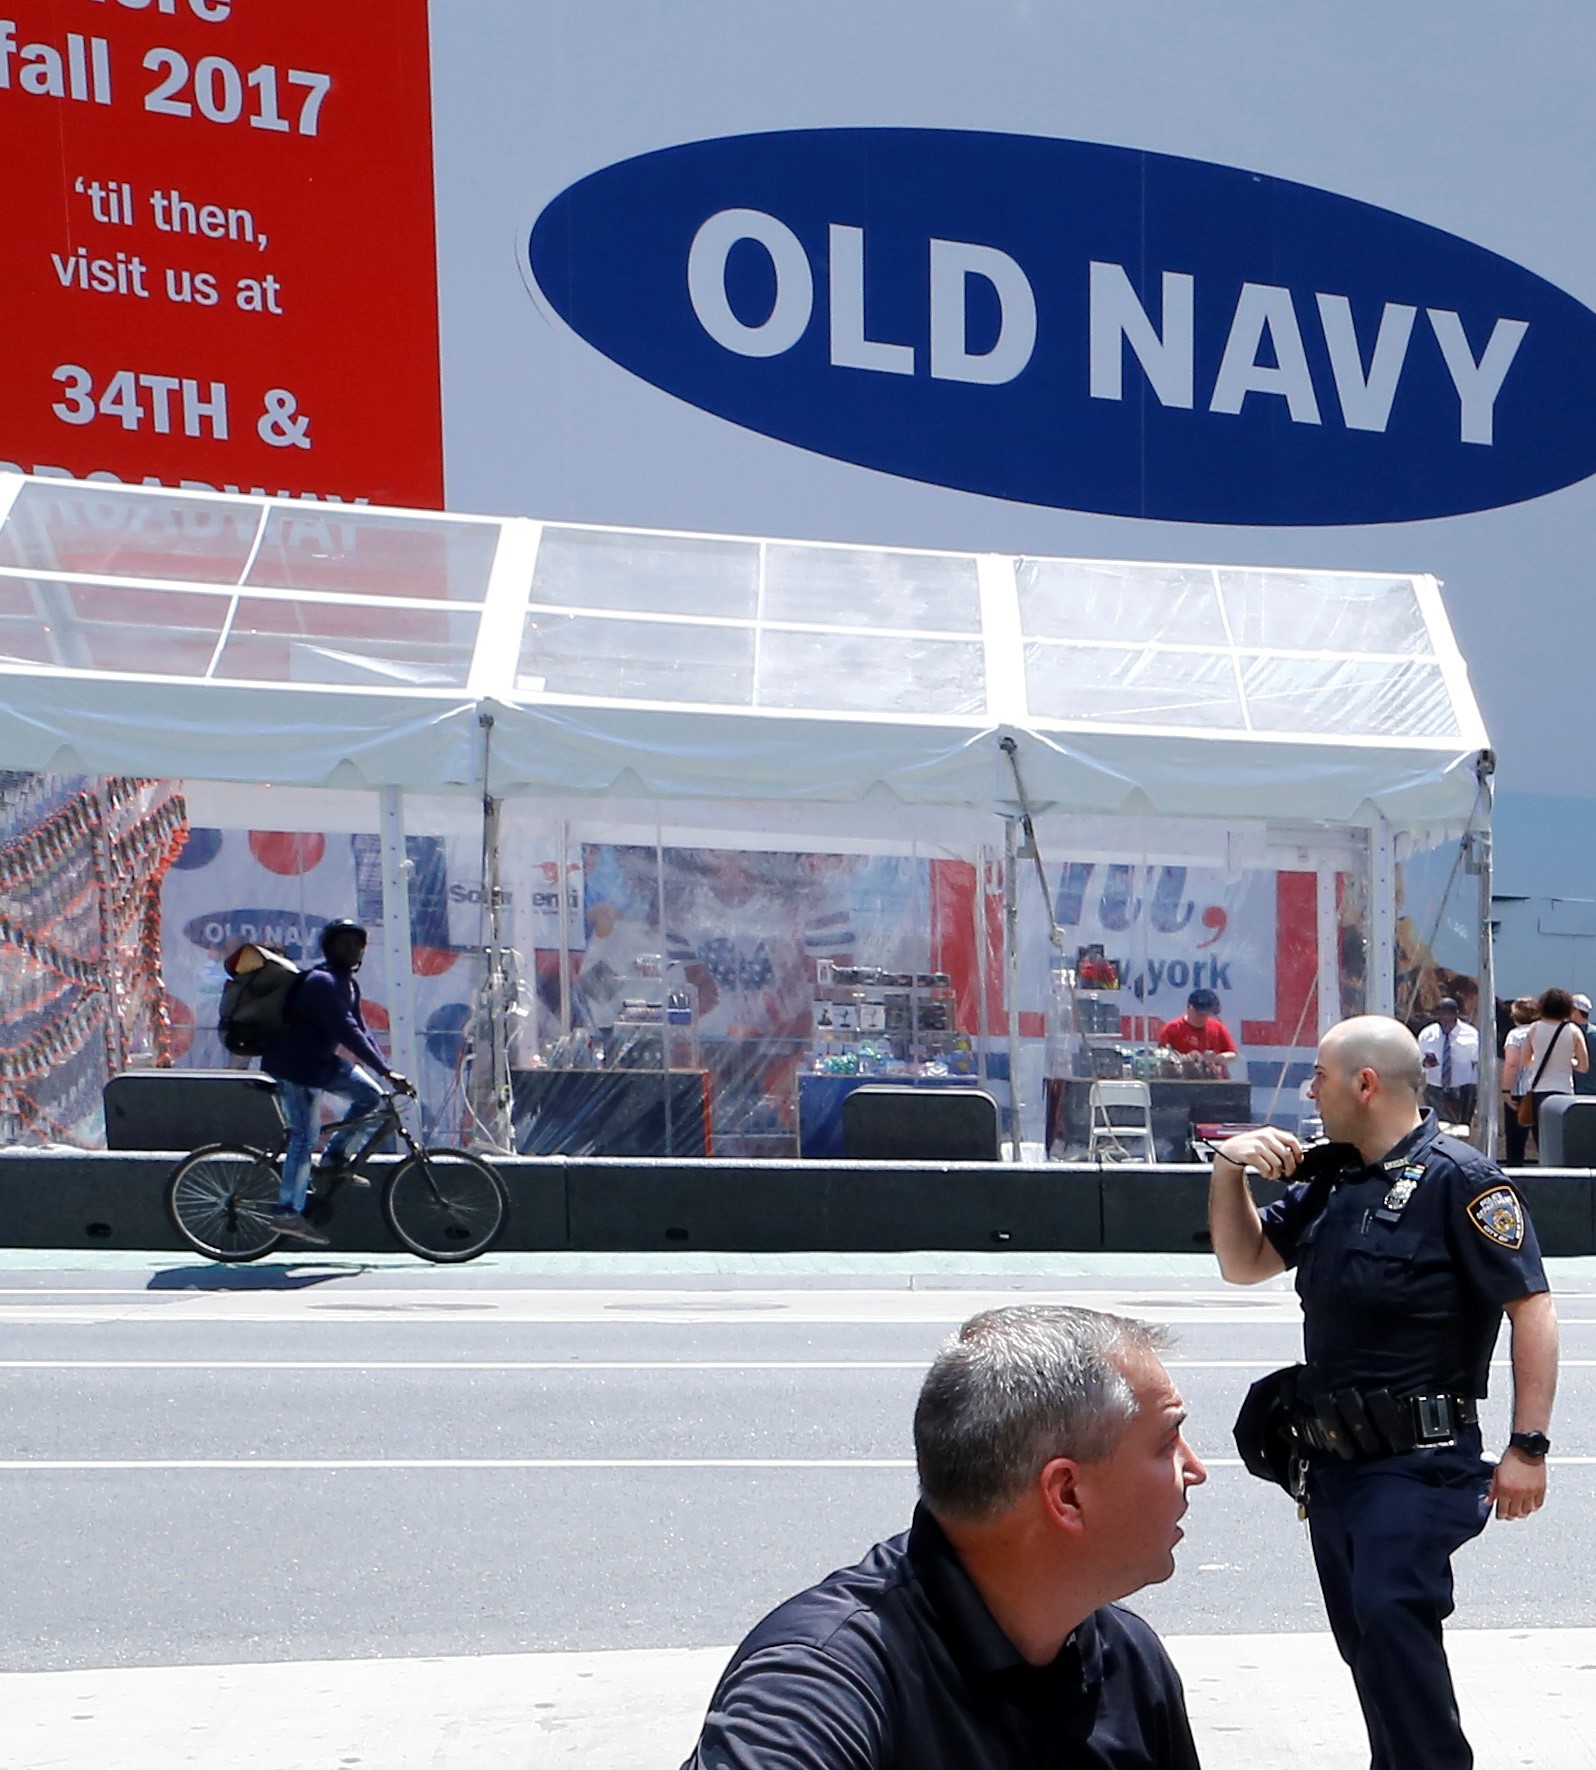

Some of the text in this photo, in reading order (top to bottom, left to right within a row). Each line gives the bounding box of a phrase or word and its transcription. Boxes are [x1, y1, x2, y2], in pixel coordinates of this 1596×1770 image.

[0, 20, 332, 137] fall 2017
[150, 188, 270, 253] then,
[51, 247, 284, 316] visit us at
[687, 207, 1530, 447] OLD NAVY
[51, 363, 313, 450] 34TH &
[205, 922, 324, 947] OLD NAV
[1147, 952, 1234, 997] york
